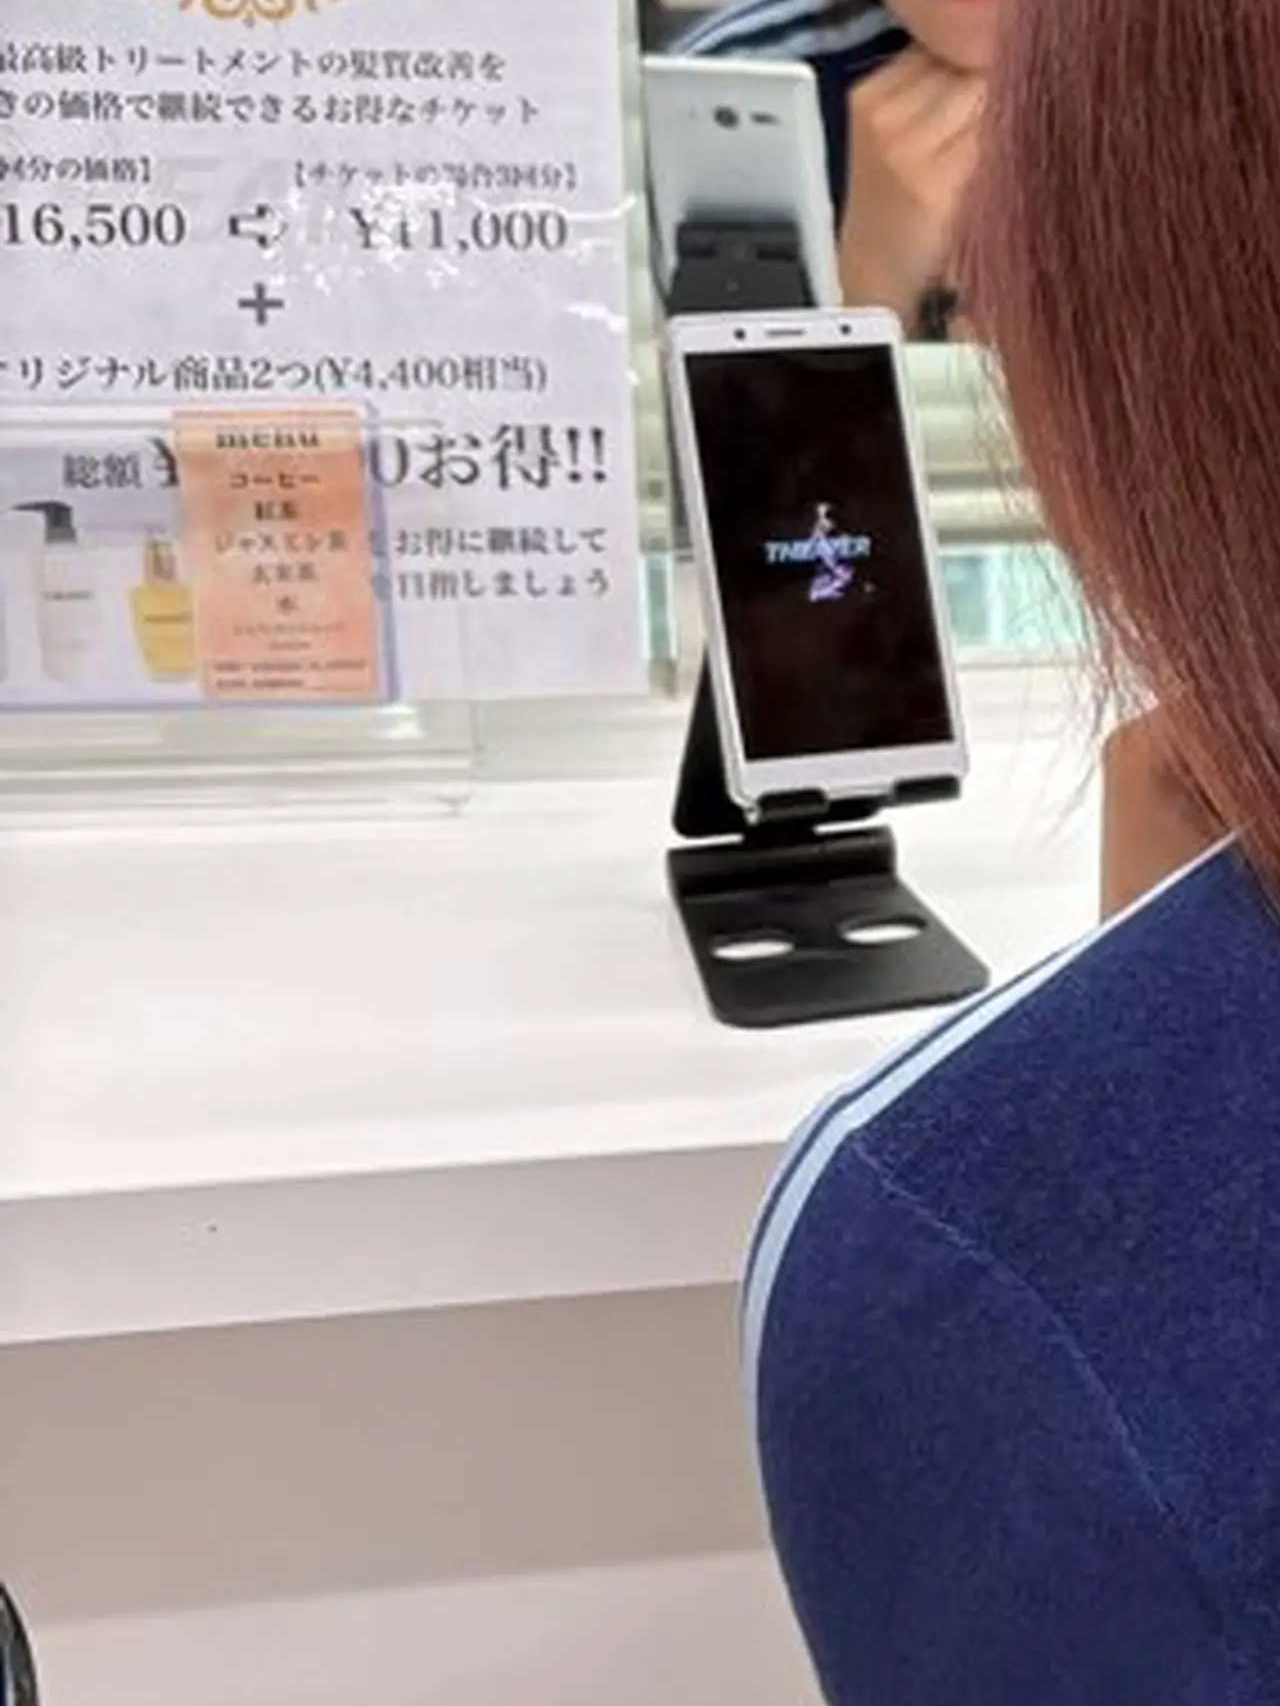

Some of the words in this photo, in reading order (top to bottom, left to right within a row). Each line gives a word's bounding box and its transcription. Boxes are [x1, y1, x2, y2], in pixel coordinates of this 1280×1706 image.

[0, 354, 548, 395] リジナル商品2つ(¥4,400相当)
